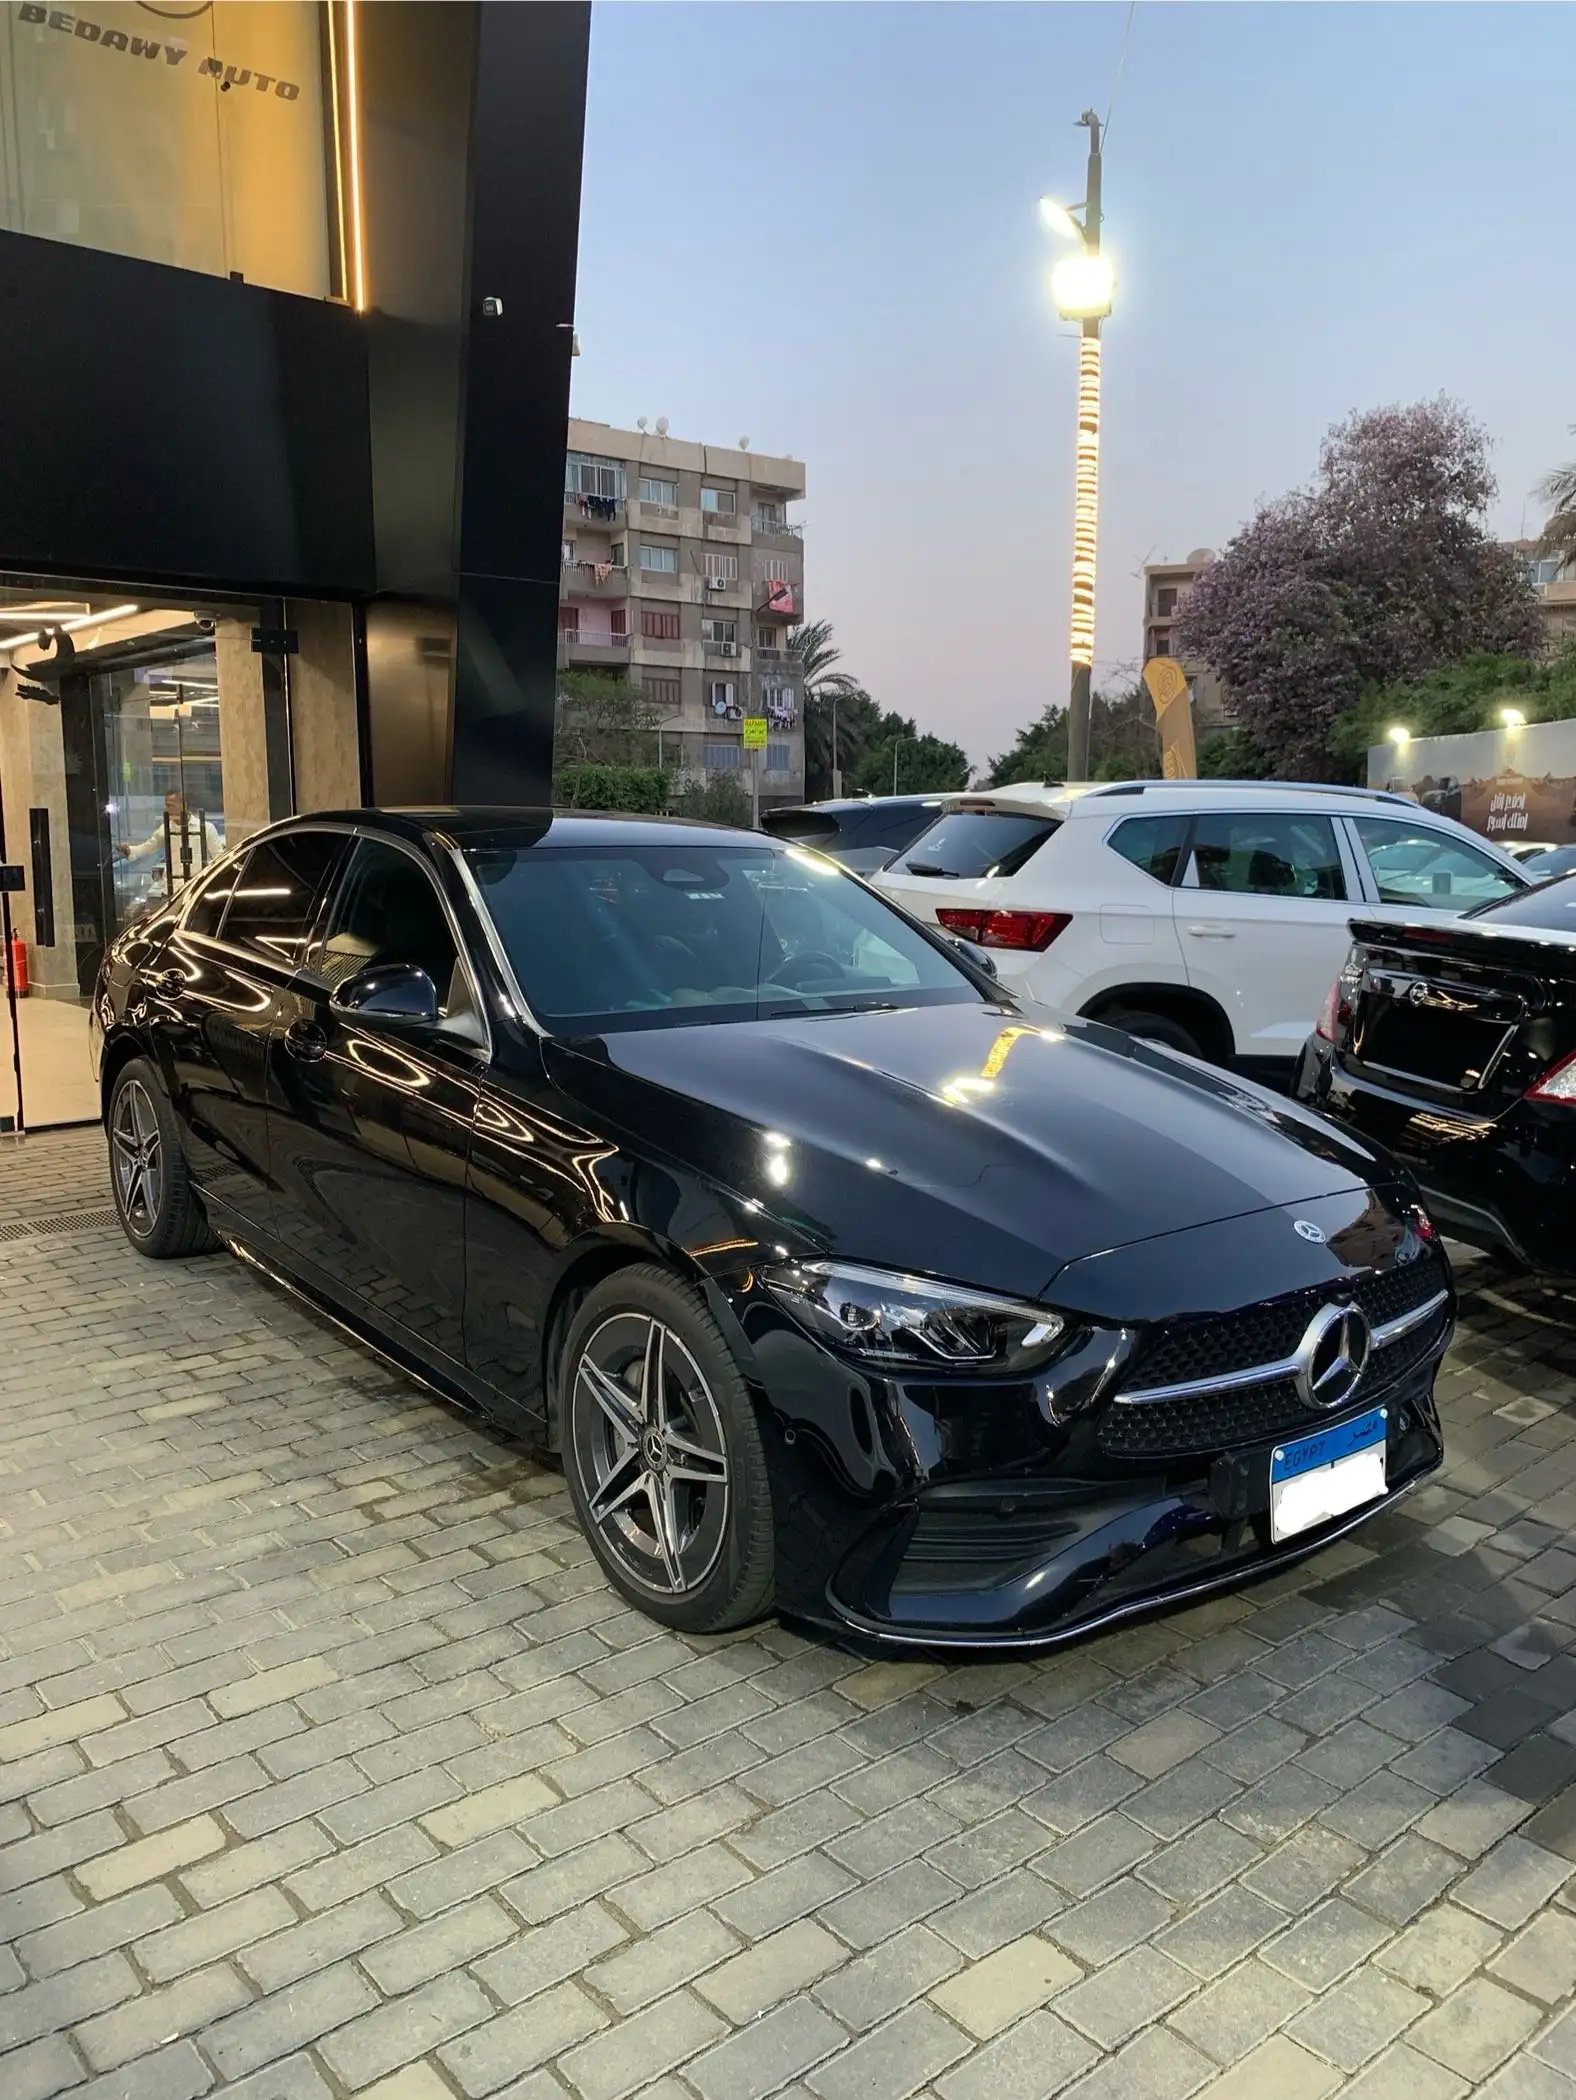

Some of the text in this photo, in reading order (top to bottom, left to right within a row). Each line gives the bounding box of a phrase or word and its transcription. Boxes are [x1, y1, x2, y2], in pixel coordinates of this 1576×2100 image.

[18, 3, 300, 101] BEDAWY AUTO
[1347, 1419, 1377, 1446] مصر
[1284, 1440, 1327, 1471] EGYPT
